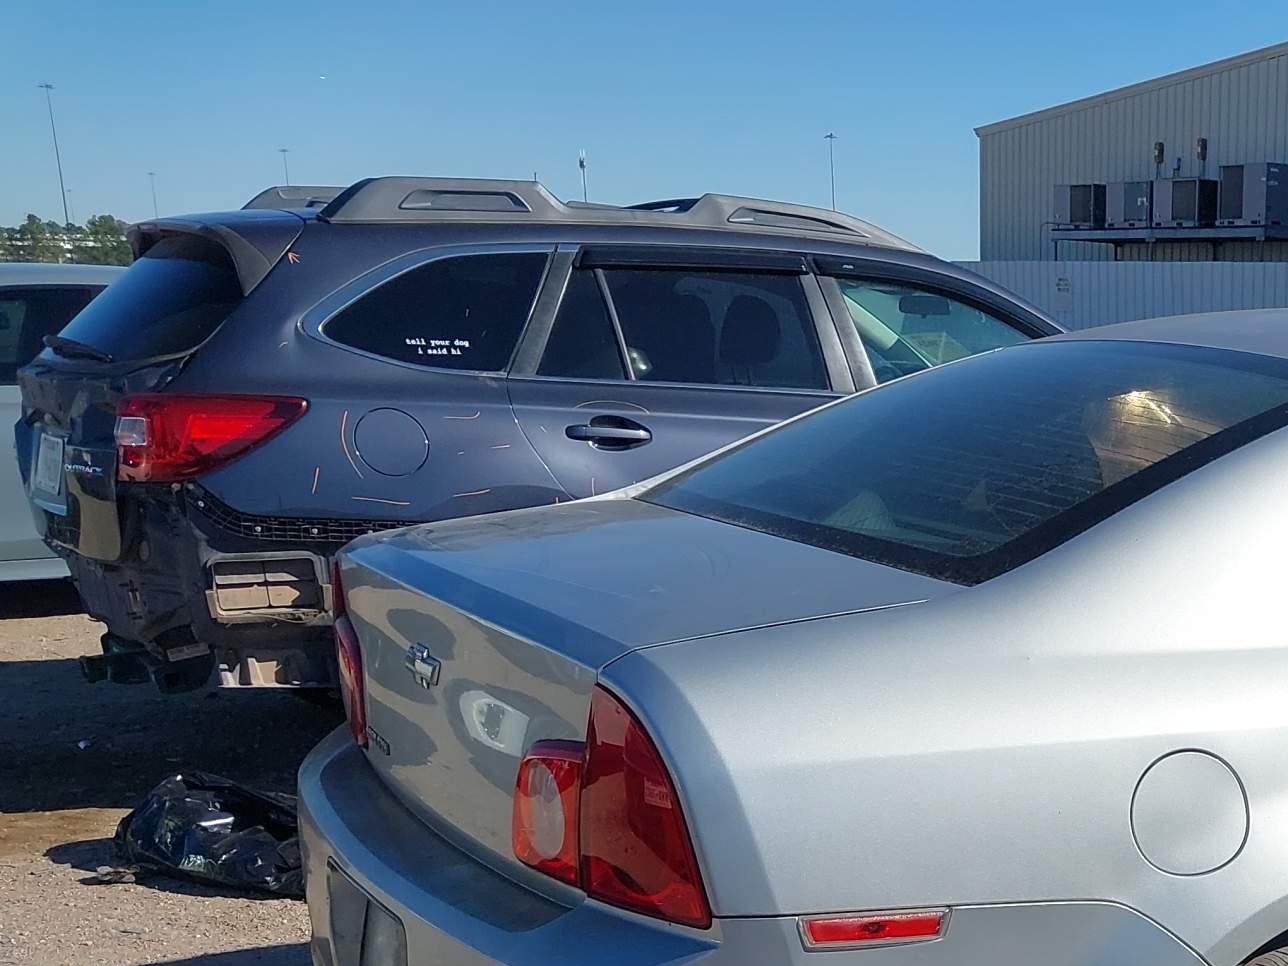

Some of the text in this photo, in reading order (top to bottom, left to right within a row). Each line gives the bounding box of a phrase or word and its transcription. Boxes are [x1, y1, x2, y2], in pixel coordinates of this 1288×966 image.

[430, 339, 451, 347] your
[454, 338, 470, 348] dog
[427, 347, 449, 355] said
[450, 347, 463, 355] hi
